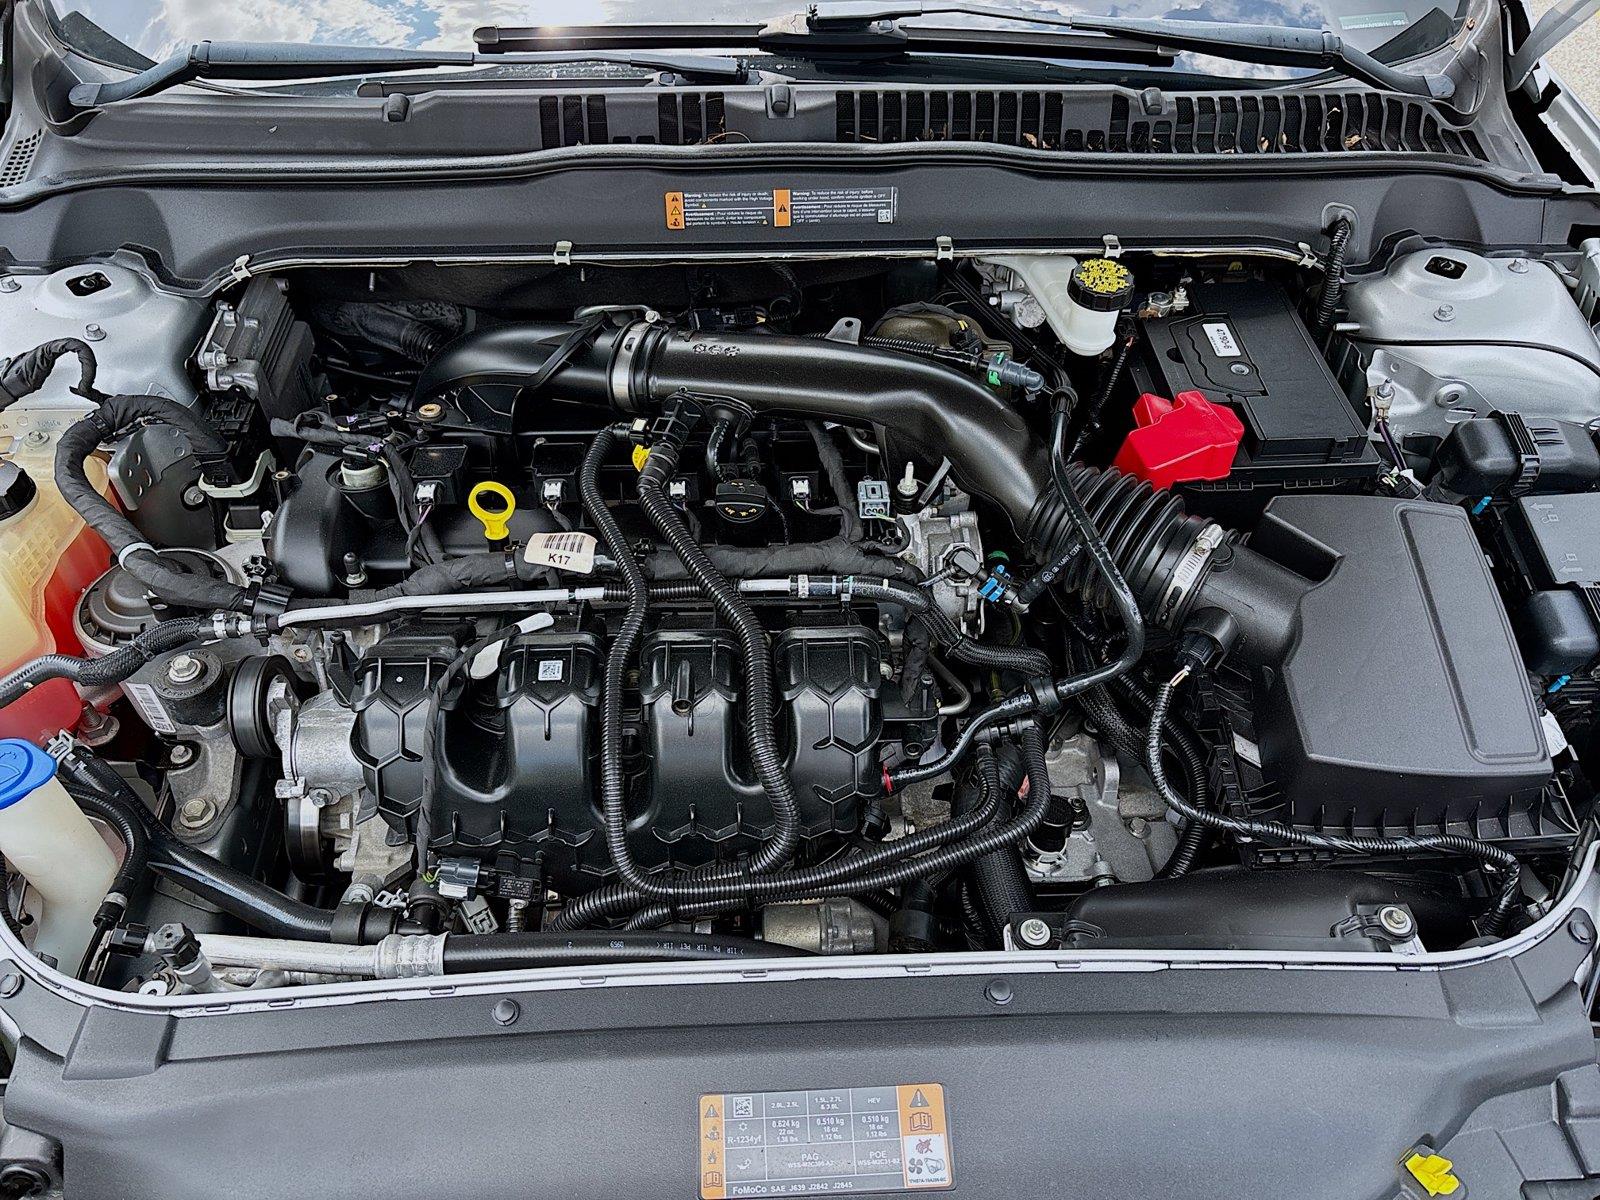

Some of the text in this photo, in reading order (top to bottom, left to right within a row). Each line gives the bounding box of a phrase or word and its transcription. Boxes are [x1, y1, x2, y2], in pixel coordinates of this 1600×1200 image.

[548, 552, 571, 565] K17
[836, 1118, 844, 1126] kg
[881, 1115, 889, 1124] kg
[791, 1120, 800, 1129] kg
[727, 1135, 761, 1145] R-1234yf
[802, 1153, 820, 1161] PAG
[869, 1151, 887, 1159] POE
